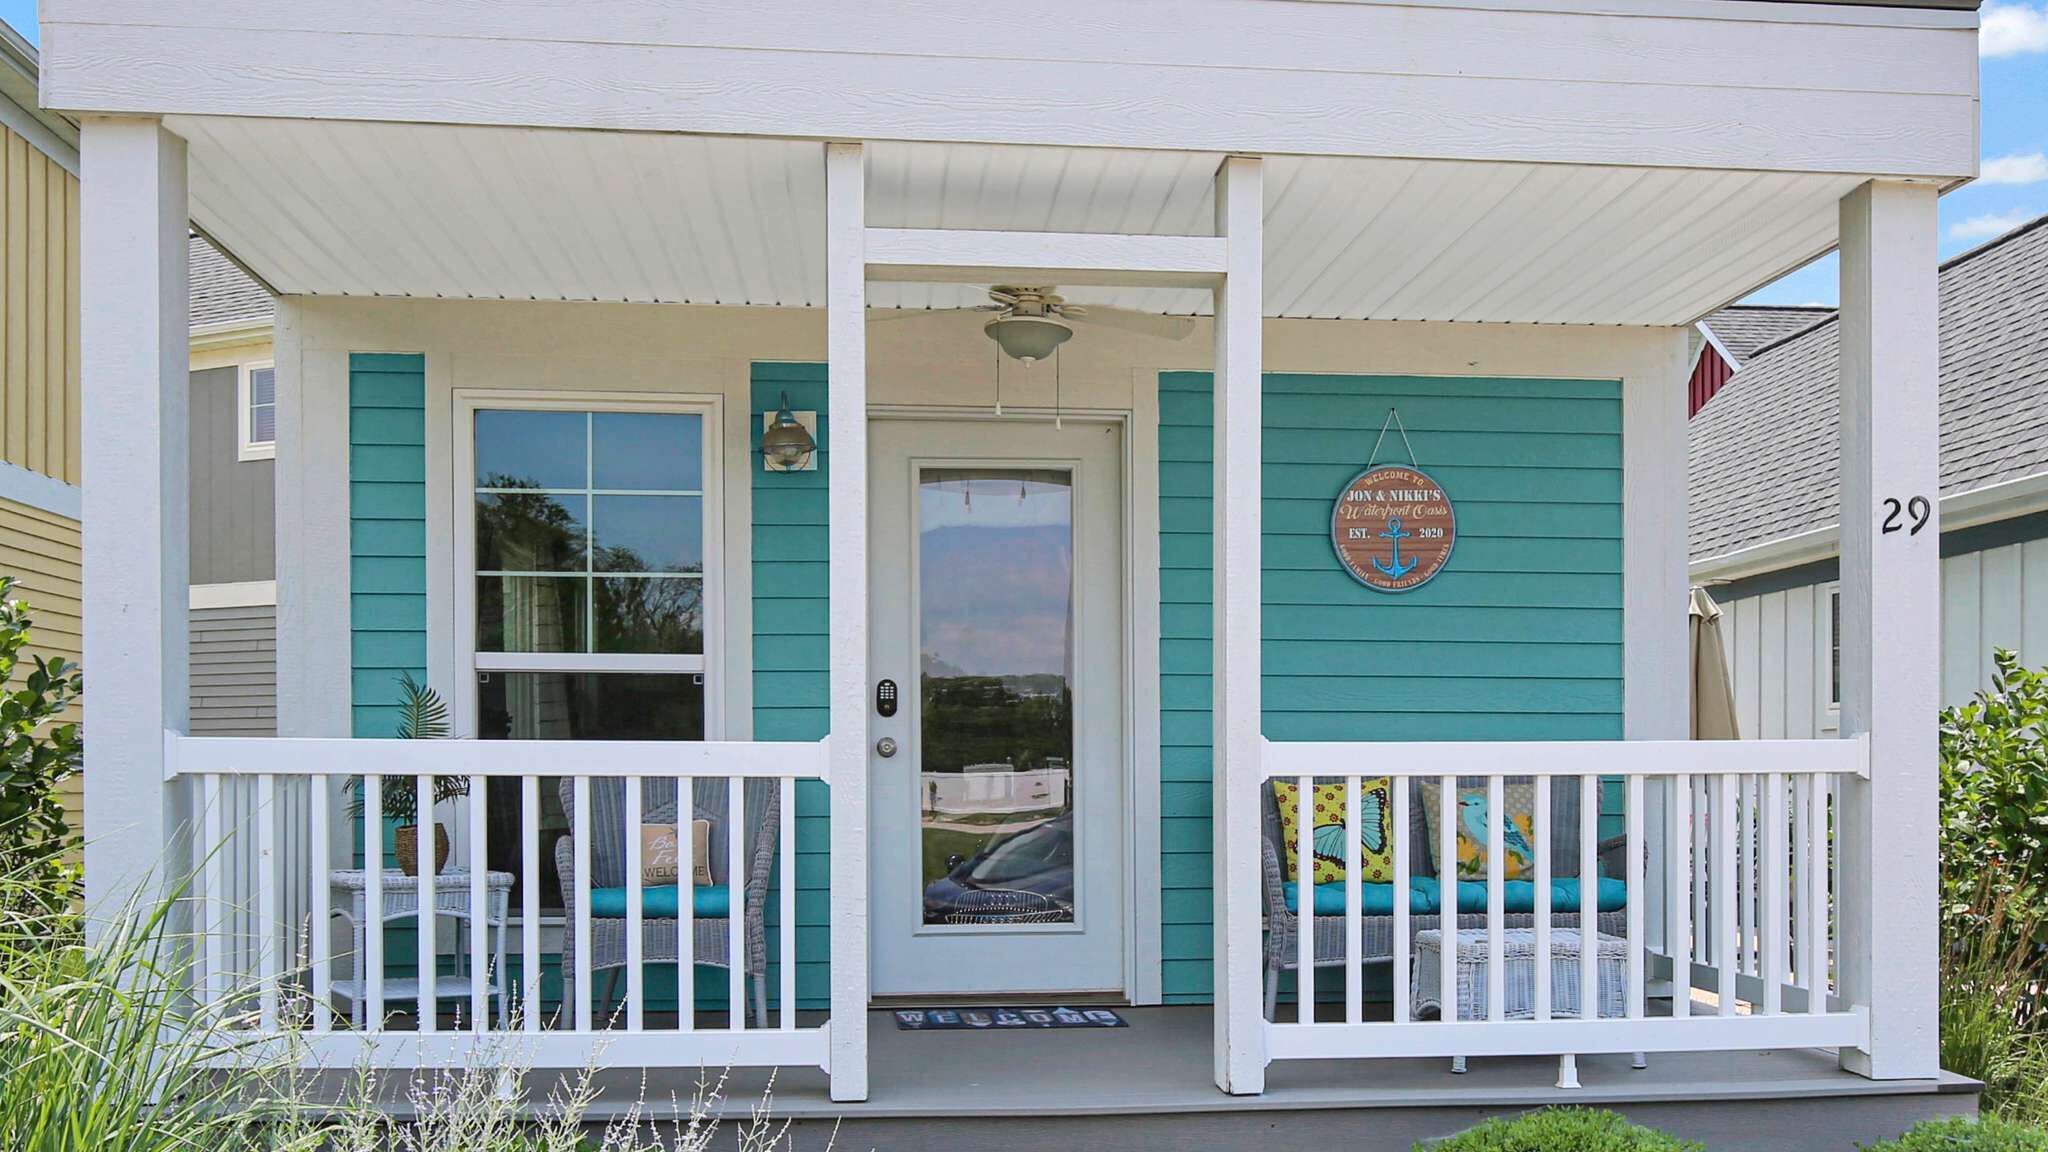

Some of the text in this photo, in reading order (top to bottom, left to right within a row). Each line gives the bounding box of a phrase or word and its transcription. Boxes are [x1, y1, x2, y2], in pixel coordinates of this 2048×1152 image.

[1364, 470, 1425, 486] WELCOME TO
[1346, 489, 1441, 502] JON & NIKKI'S
[1340, 503, 1448, 520] Waterfront Oasis
[1882, 495, 1931, 536] 29
[1348, 527, 1371, 539] EST.
[1418, 527, 1444, 539] 2020
[644, 865, 705, 878] WELCE
